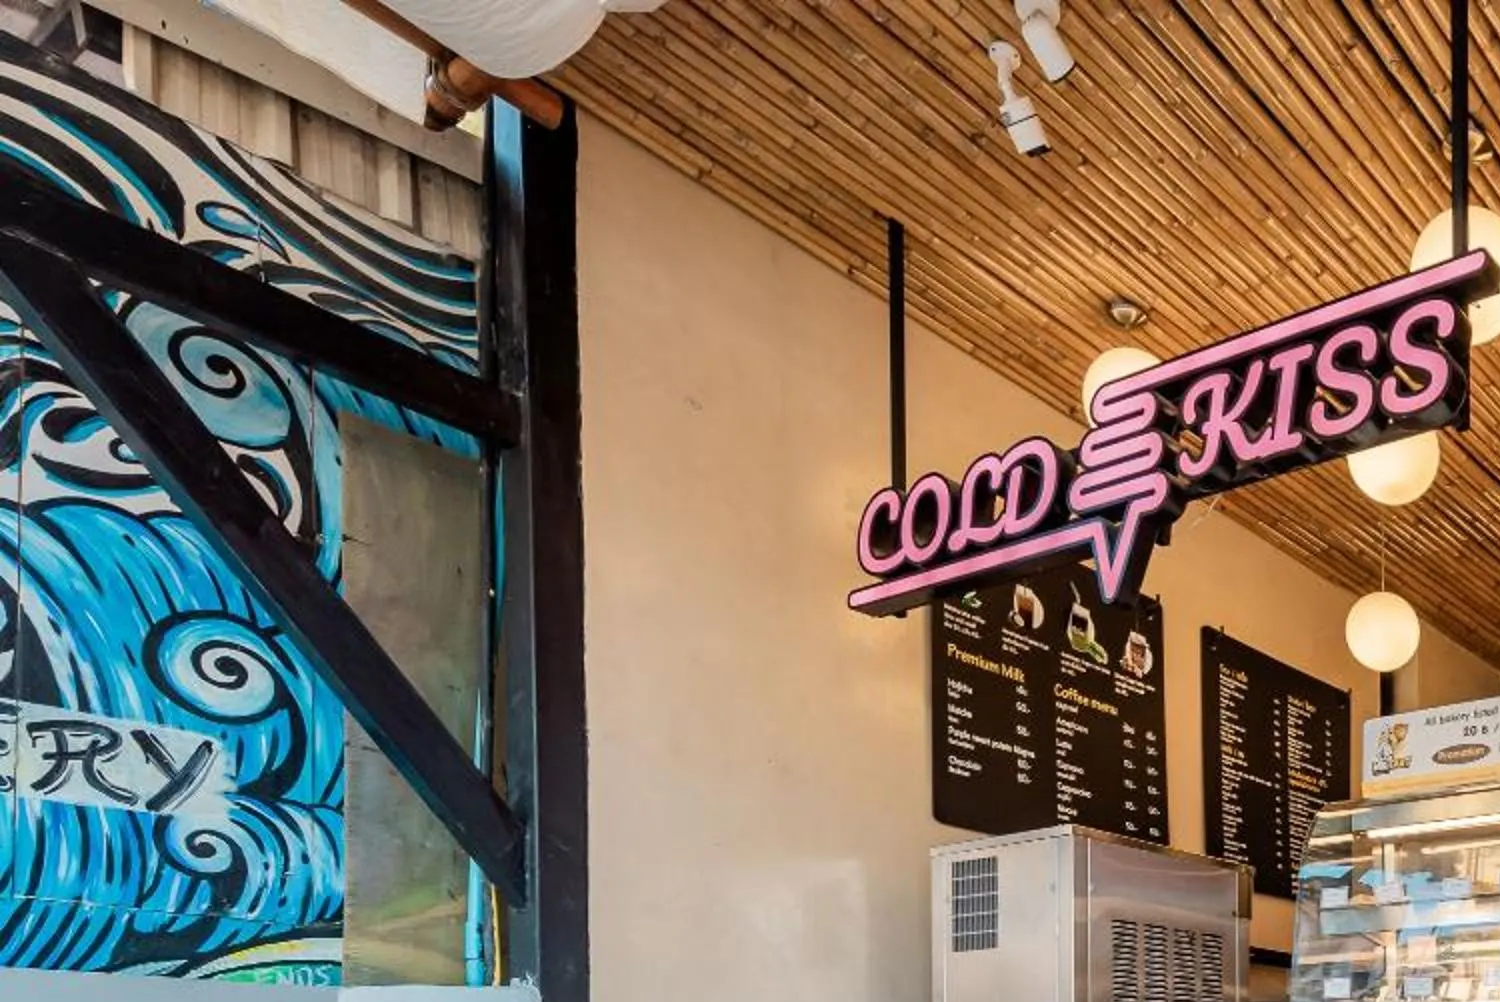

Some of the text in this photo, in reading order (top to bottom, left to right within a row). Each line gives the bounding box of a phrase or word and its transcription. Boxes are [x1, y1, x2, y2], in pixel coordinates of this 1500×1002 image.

[857, 297, 1458, 575] COLD KISS
[947, 643, 1025, 682] Premium Milk
[1054, 683, 1088, 706] Coffee
